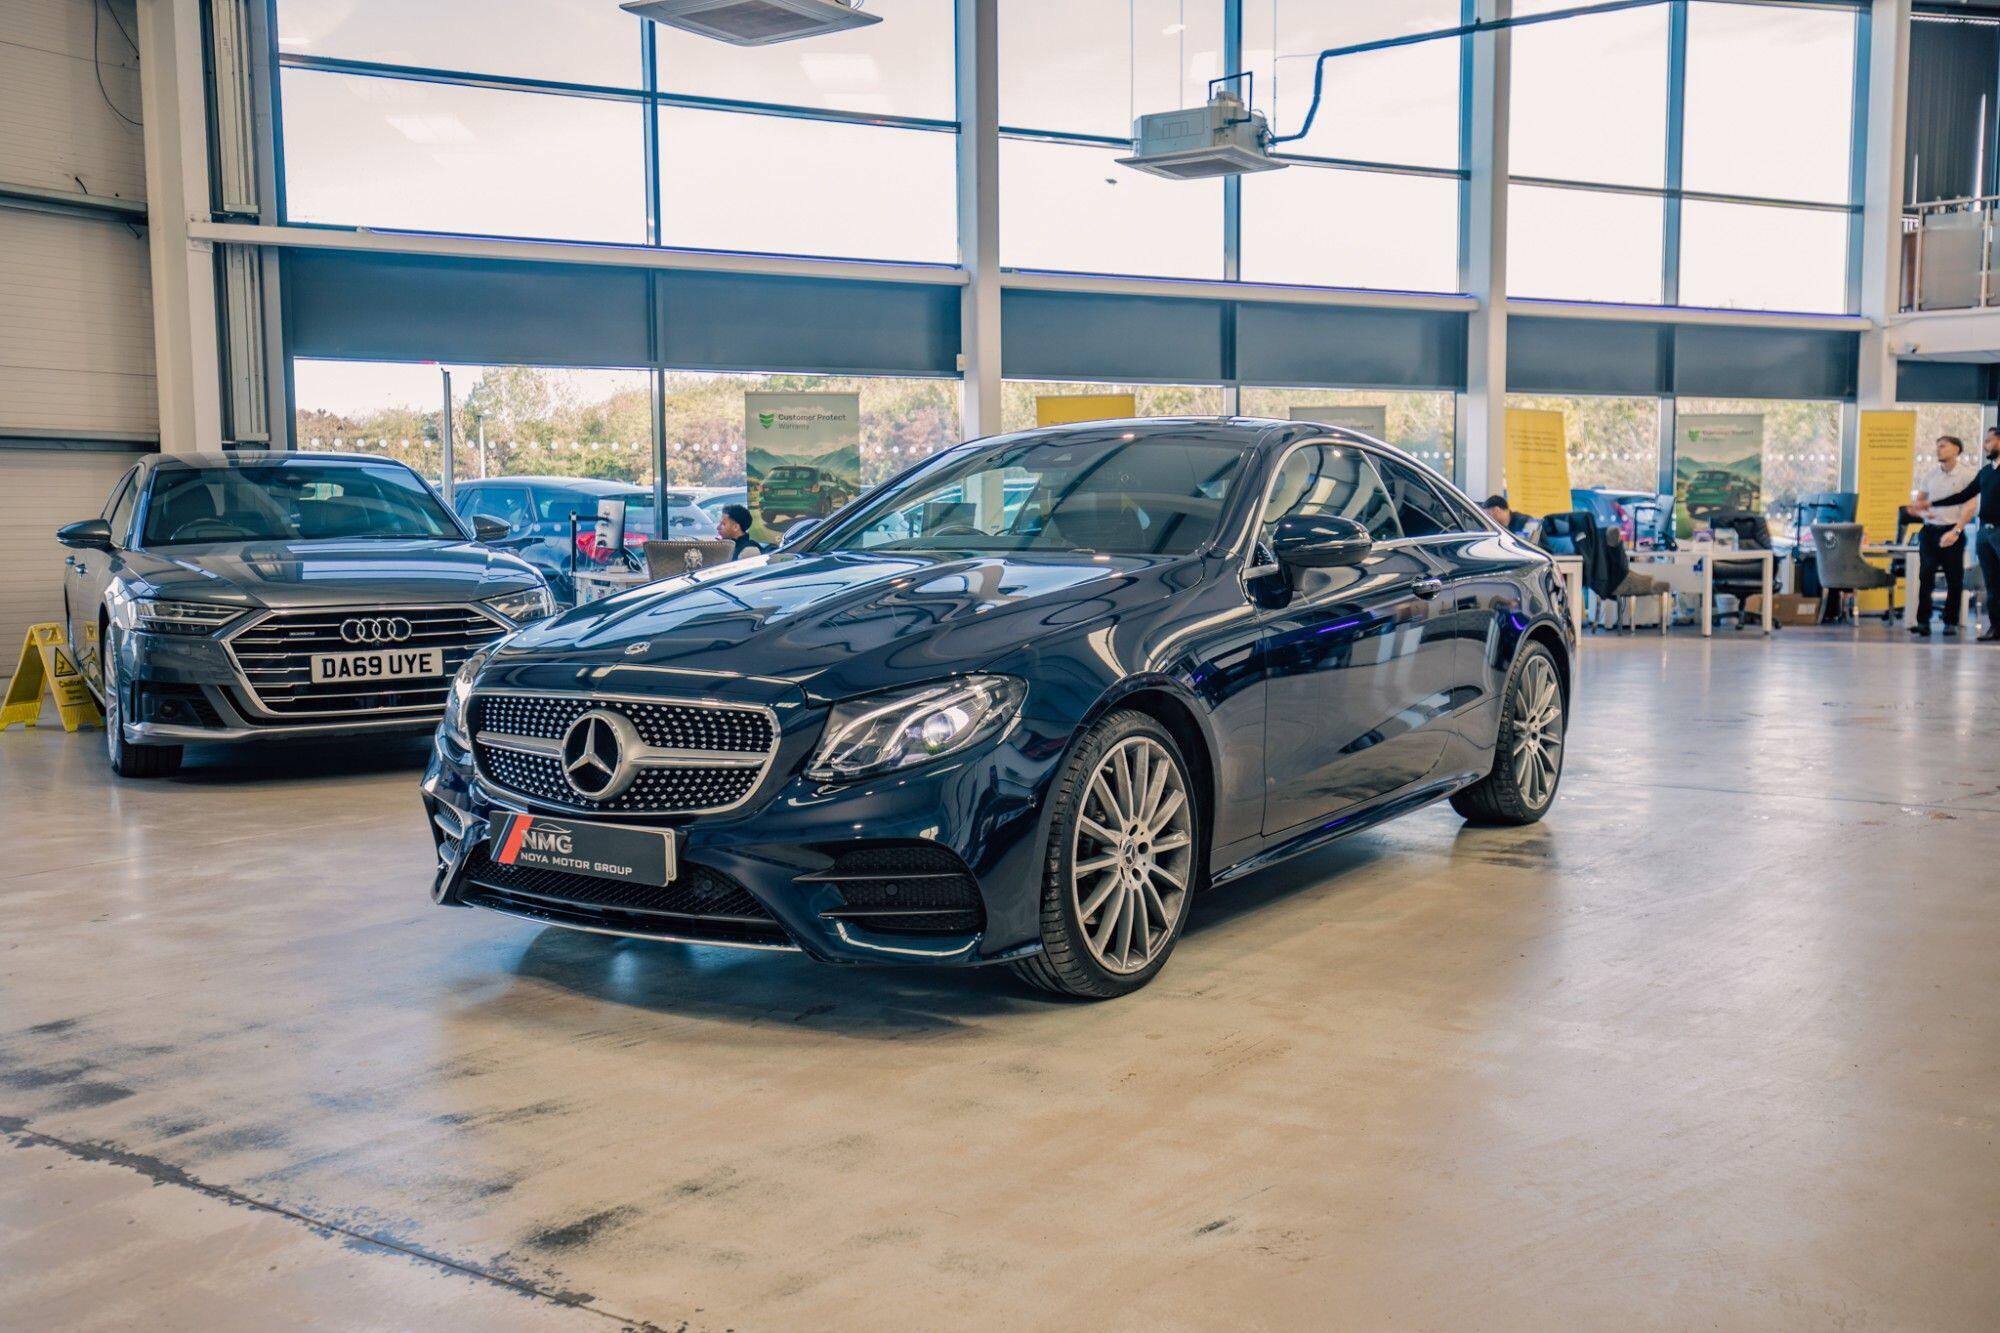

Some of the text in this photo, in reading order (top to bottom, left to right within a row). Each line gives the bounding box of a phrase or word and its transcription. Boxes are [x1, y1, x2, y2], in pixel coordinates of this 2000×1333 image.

[778, 413, 847, 422] Customer Protect
[778, 423, 810, 431] Warranty
[321, 653, 433, 679] DA69 UYE
[520, 828, 573, 855] NMG
[520, 852, 633, 875] NOYA MOTOR GROUP
